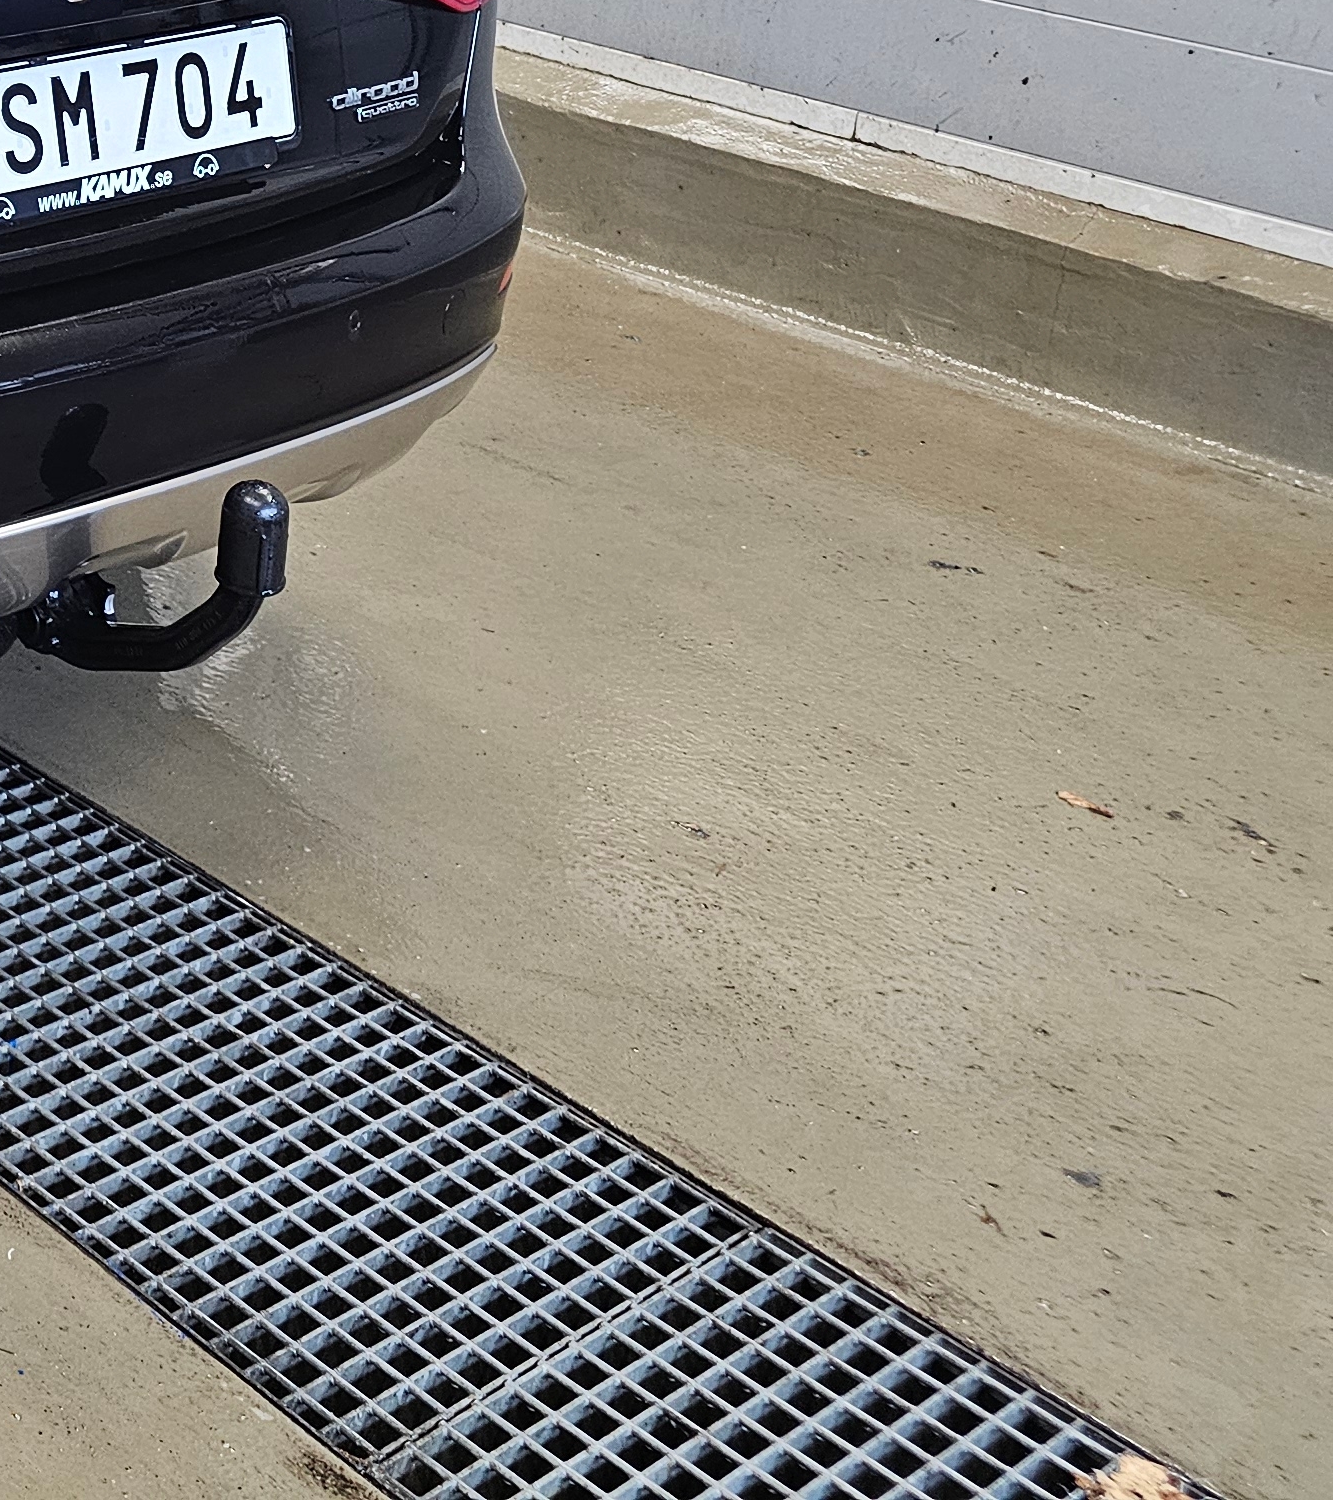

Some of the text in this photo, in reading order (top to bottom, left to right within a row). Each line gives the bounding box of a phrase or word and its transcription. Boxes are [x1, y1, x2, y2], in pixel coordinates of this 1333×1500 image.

[121, 42, 263, 153] 704
[332, 70, 419, 111] allroad
[359, 95, 418, 120] quattro
[37, 164, 173, 213] www.KAMUX.se
